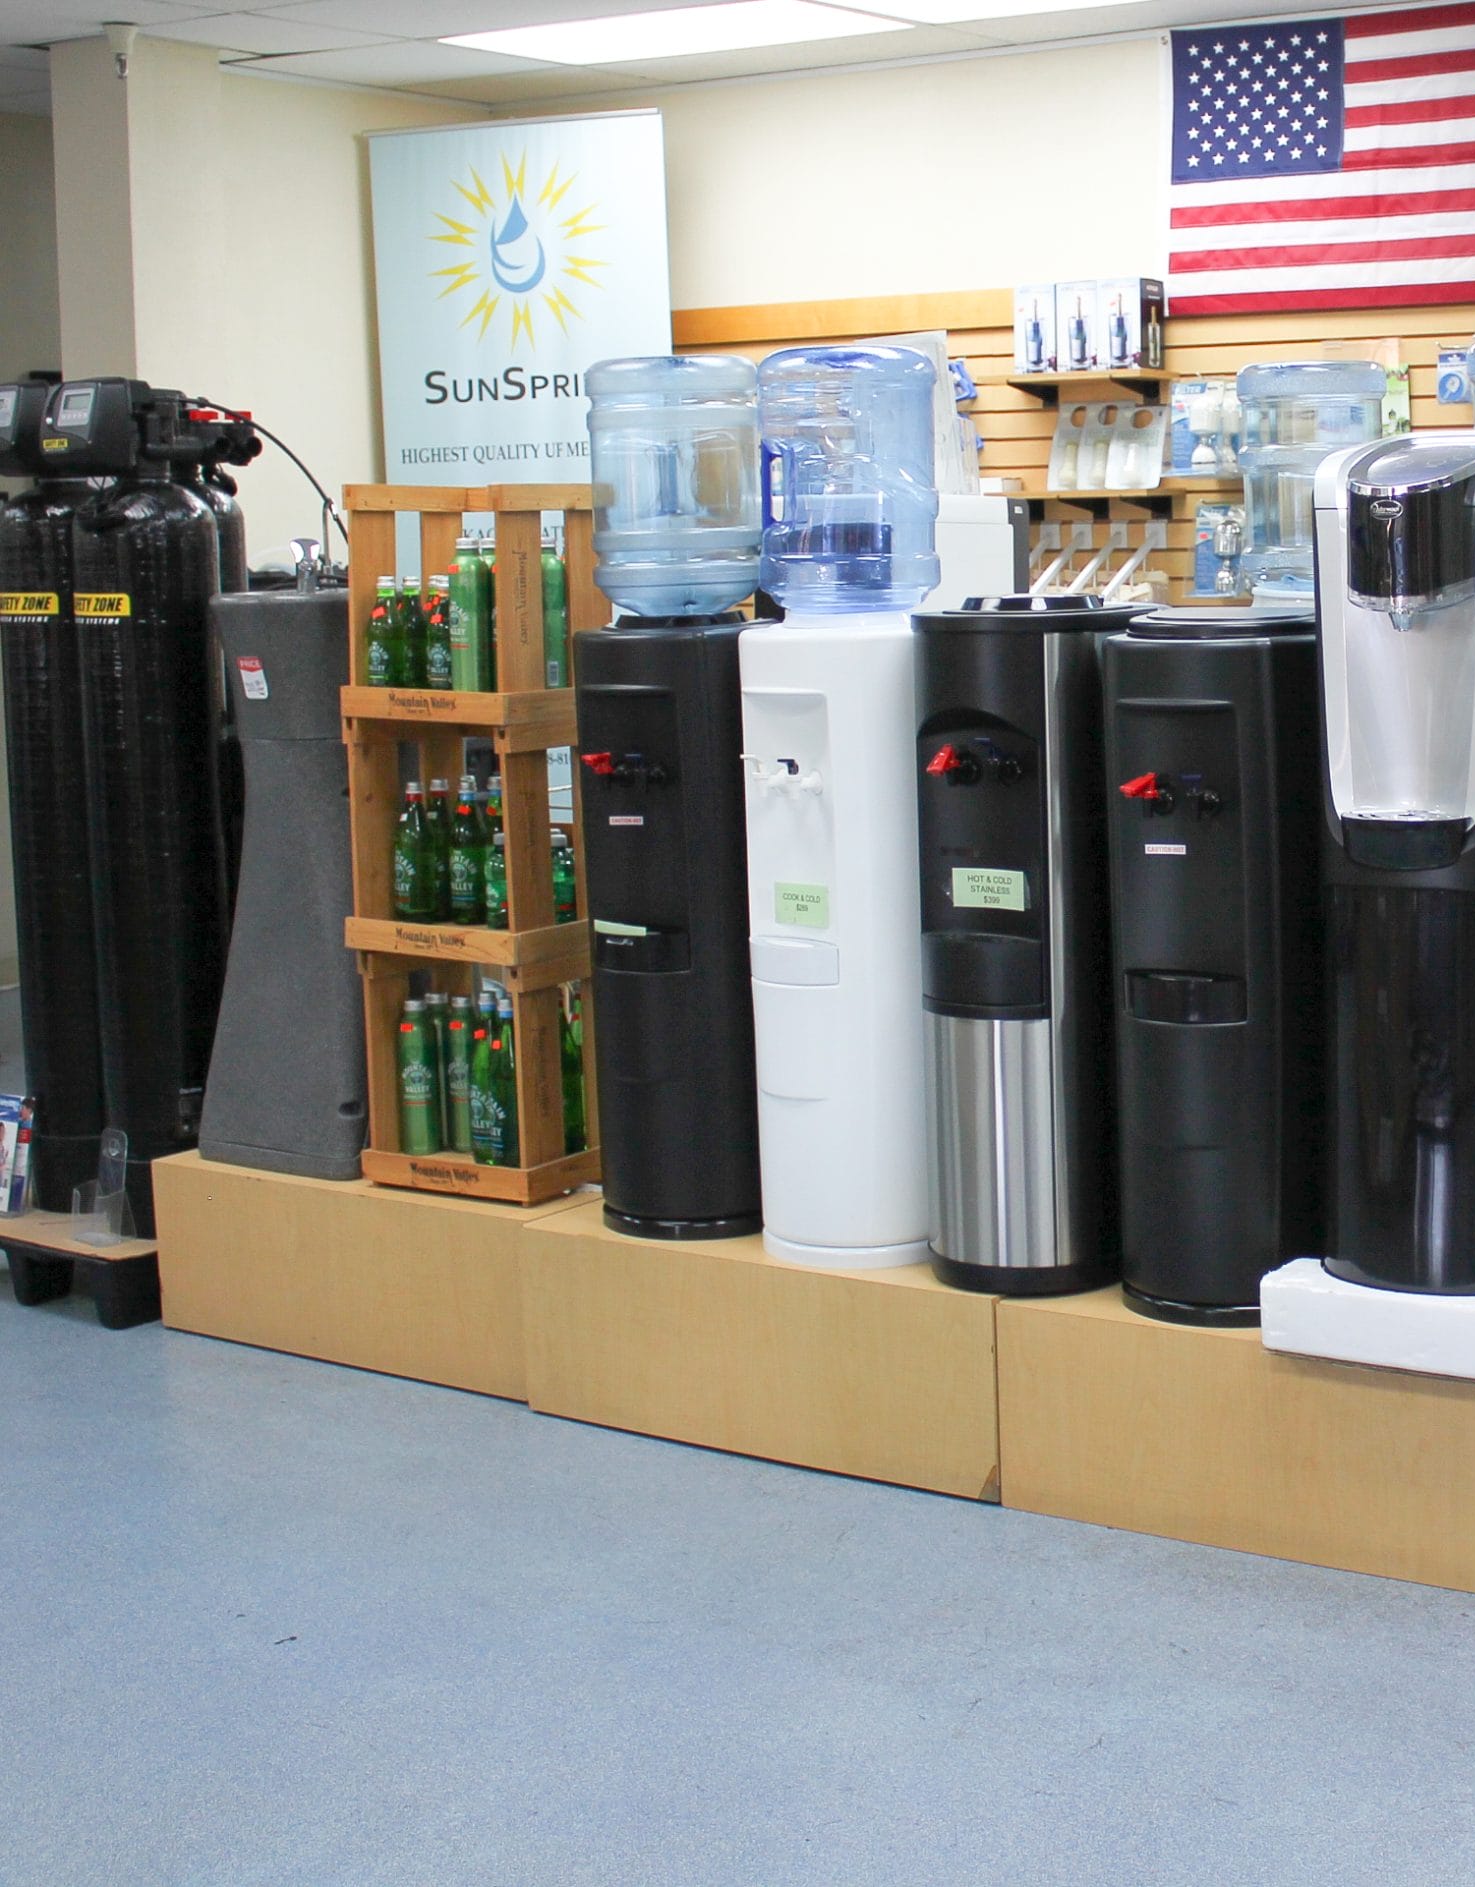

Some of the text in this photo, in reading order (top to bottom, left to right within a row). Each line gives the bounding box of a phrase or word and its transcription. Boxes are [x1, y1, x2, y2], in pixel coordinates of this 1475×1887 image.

[401, 446, 469, 465] HIGHEST
[473, 443, 540, 463] QUALITY
[544, 443, 567, 460] UF
[22, 596, 52, 610] ZONE
[93, 597, 123, 612] ZONE
[388, 690, 431, 714] Mountain
[967, 874, 1012, 884] HOT & COLD
[970, 885, 1010, 895] STAINLESS
[805, 894, 821, 903] COLD
[983, 896, 1001, 904] $399
[396, 927, 466, 950] Mountain Valley
[405, 1084, 430, 1093] VALLEY
[410, 1162, 453, 1186] Mountain
